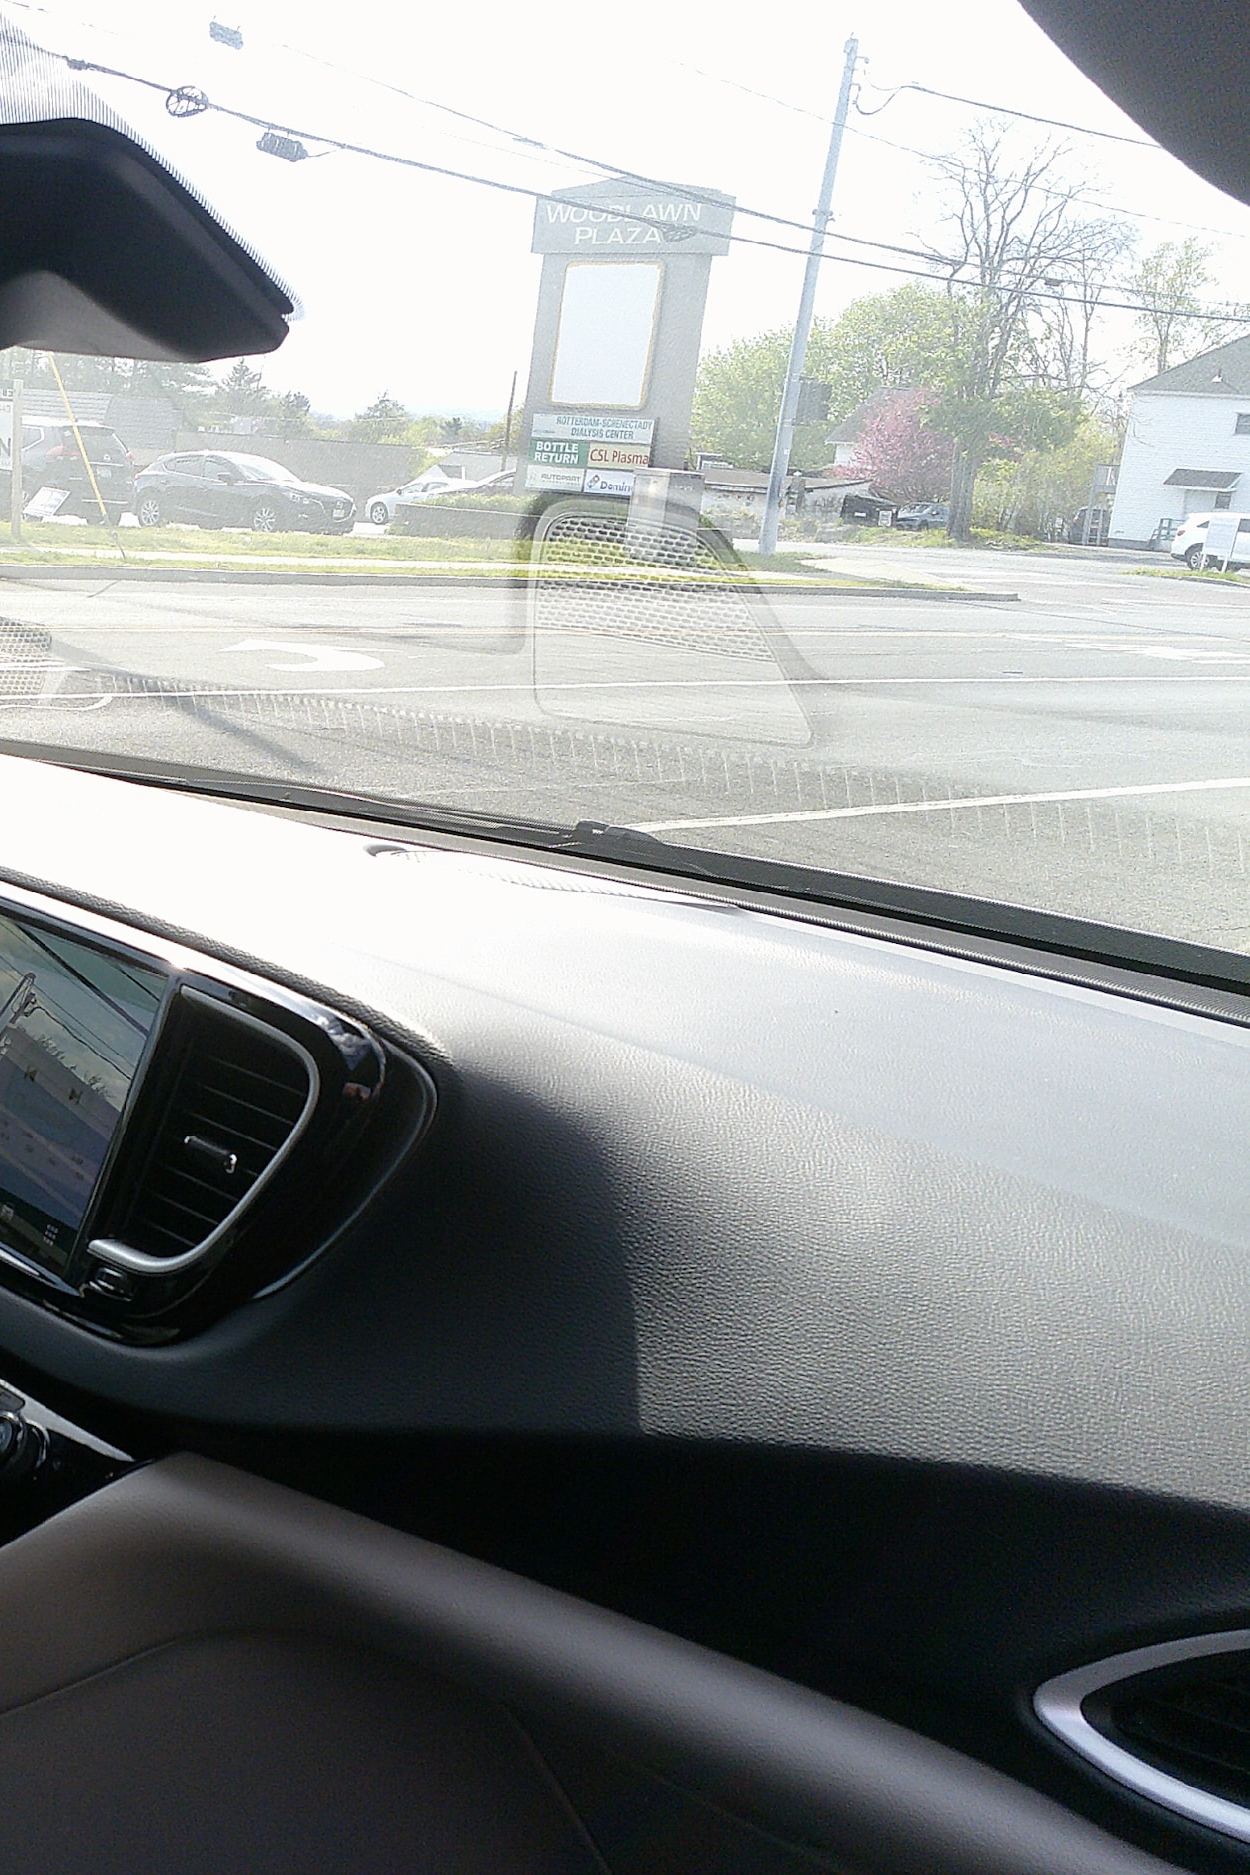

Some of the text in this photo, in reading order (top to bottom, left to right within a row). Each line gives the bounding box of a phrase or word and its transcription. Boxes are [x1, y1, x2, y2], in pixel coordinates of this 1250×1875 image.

[546, 203, 702, 223] WOODLAWN
[574, 227, 663, 245] PLAZA
[556, 416, 652, 430] ROTTERDAM-SCHENECTADY
[570, 427, 634, 440] DIALYSIS CENTER
[536, 441, 579, 452] BOTTLE
[534, 452, 579, 464] RETURN
[590, 449, 649, 465] CSL Plasma
[541, 473, 581, 482] AUTOPART
[600, 481, 632, 492] Domin
